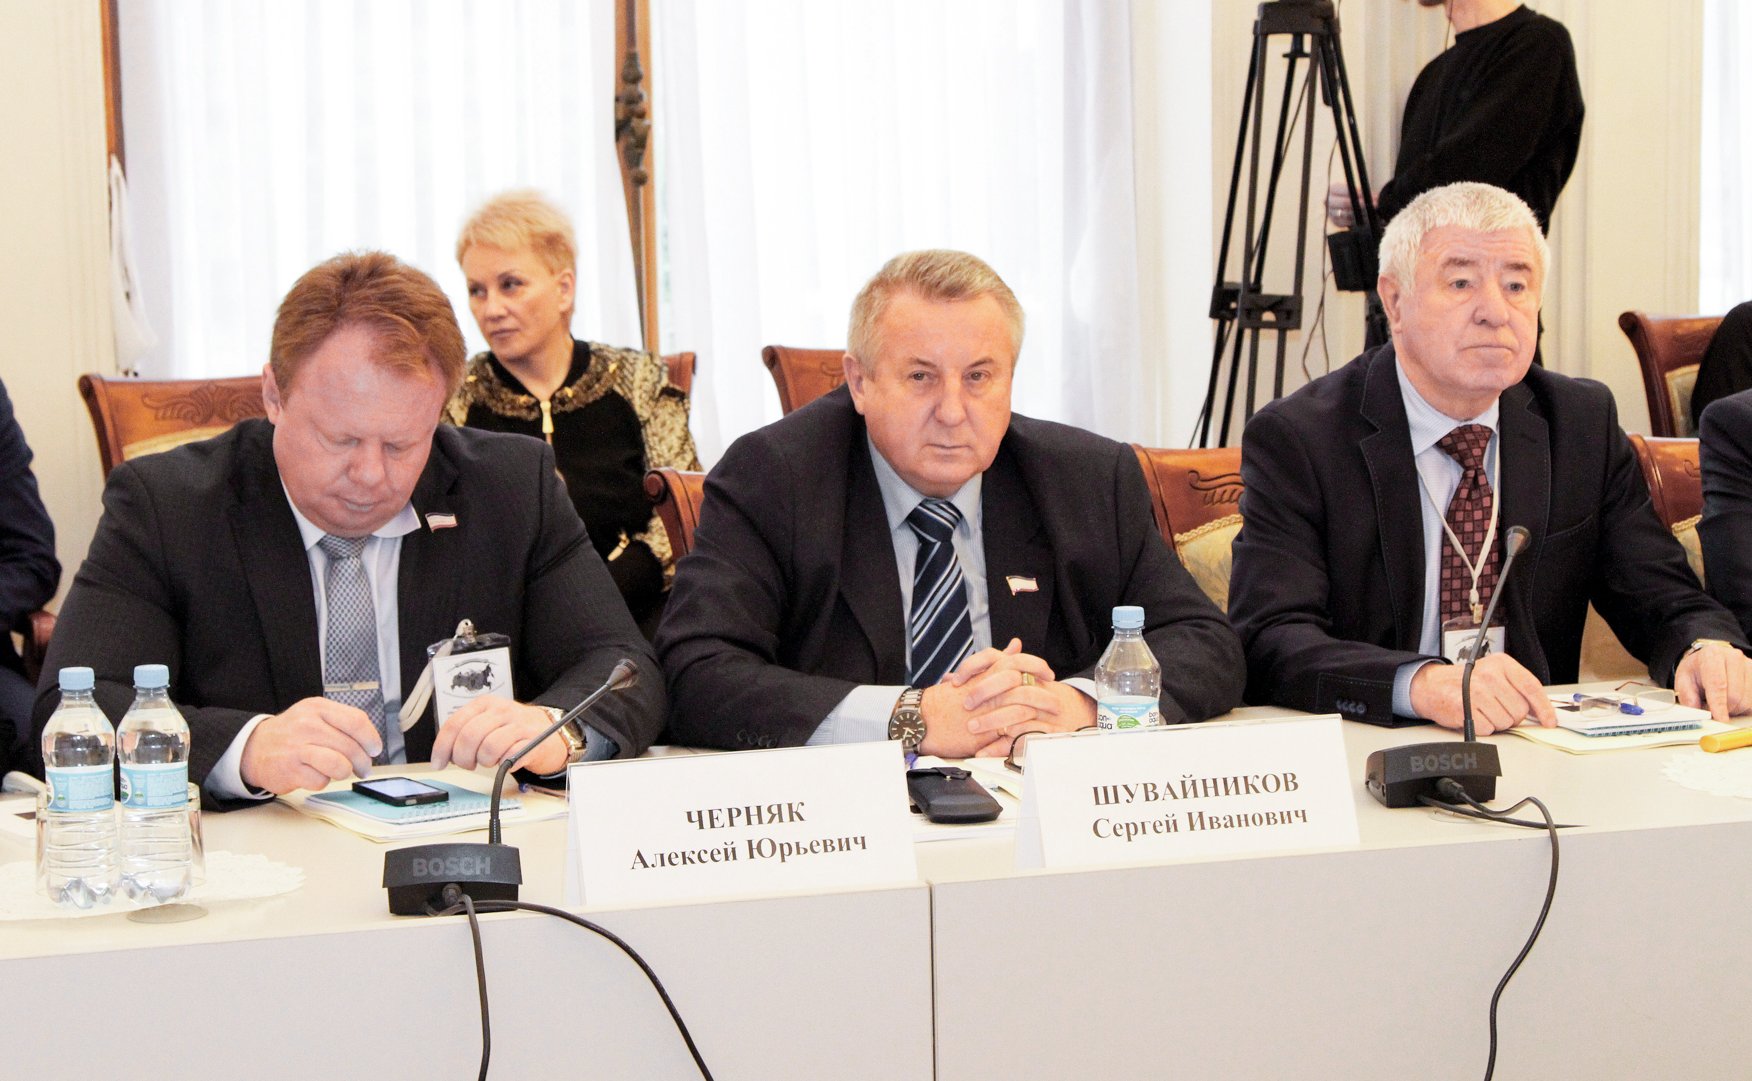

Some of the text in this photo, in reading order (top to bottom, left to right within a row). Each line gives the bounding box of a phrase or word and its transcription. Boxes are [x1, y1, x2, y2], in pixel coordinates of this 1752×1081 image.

[1410, 752, 1478, 773] BOSCH
[1092, 772, 1299, 806] ШУВАЙНИКОВ
[685, 801, 806, 830] ЧЕРНЯК
[1092, 808, 1308, 842] Сергей Иванович
[412, 856, 491, 877] BOSCH
[631, 834, 867, 870] Алексей Юрьевич
